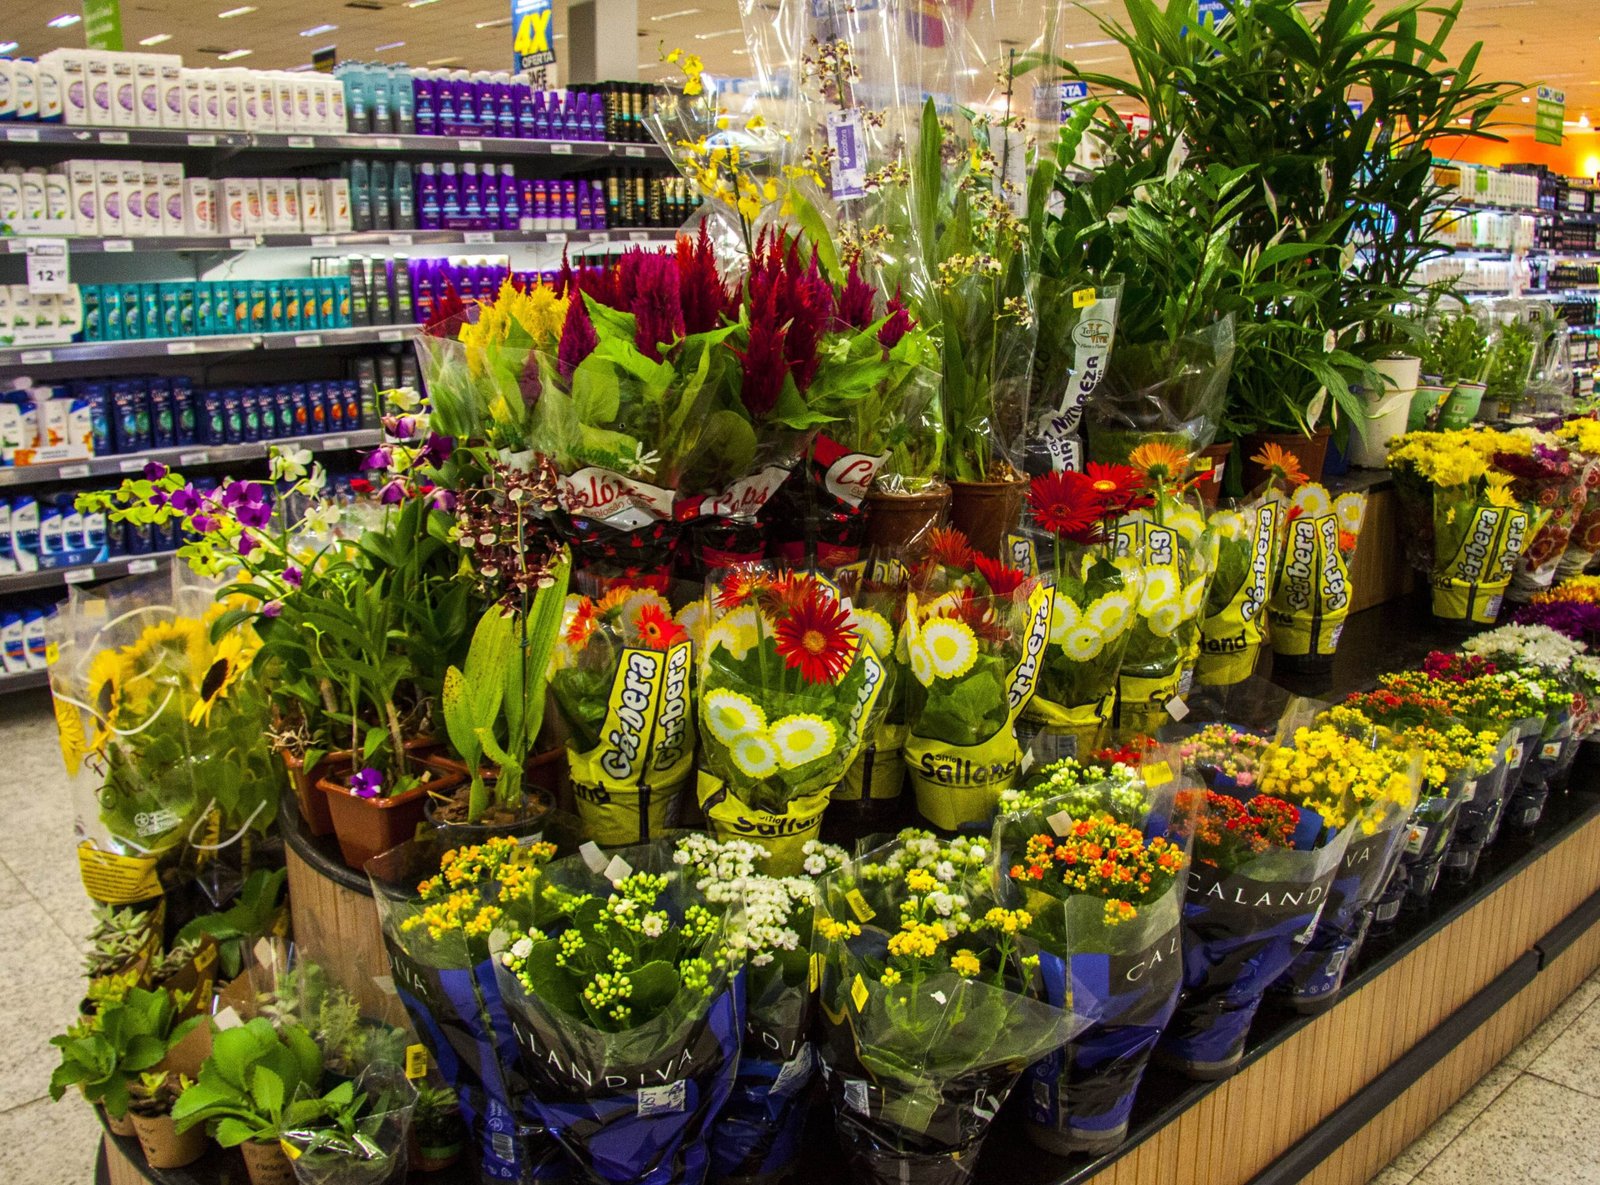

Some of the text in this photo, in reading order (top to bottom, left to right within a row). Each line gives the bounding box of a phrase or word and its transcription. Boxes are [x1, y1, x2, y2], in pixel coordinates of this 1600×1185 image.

[514, 9, 551, 57] 4X
[522, 51, 554, 68] OFERTA
[37, 270, 54, 281] 12
[1286, 521, 1315, 611] Gérbera
[1200, 628, 1247, 653] land
[601, 651, 657, 779] Gérbera
[653, 646, 688, 771] Gérbera
[920, 751, 1017, 786] Salland
[1346, 847, 1373, 868] VA
[1126, 936, 1179, 984] CAL
[512, 1021, 694, 1089] ALANDIVA
